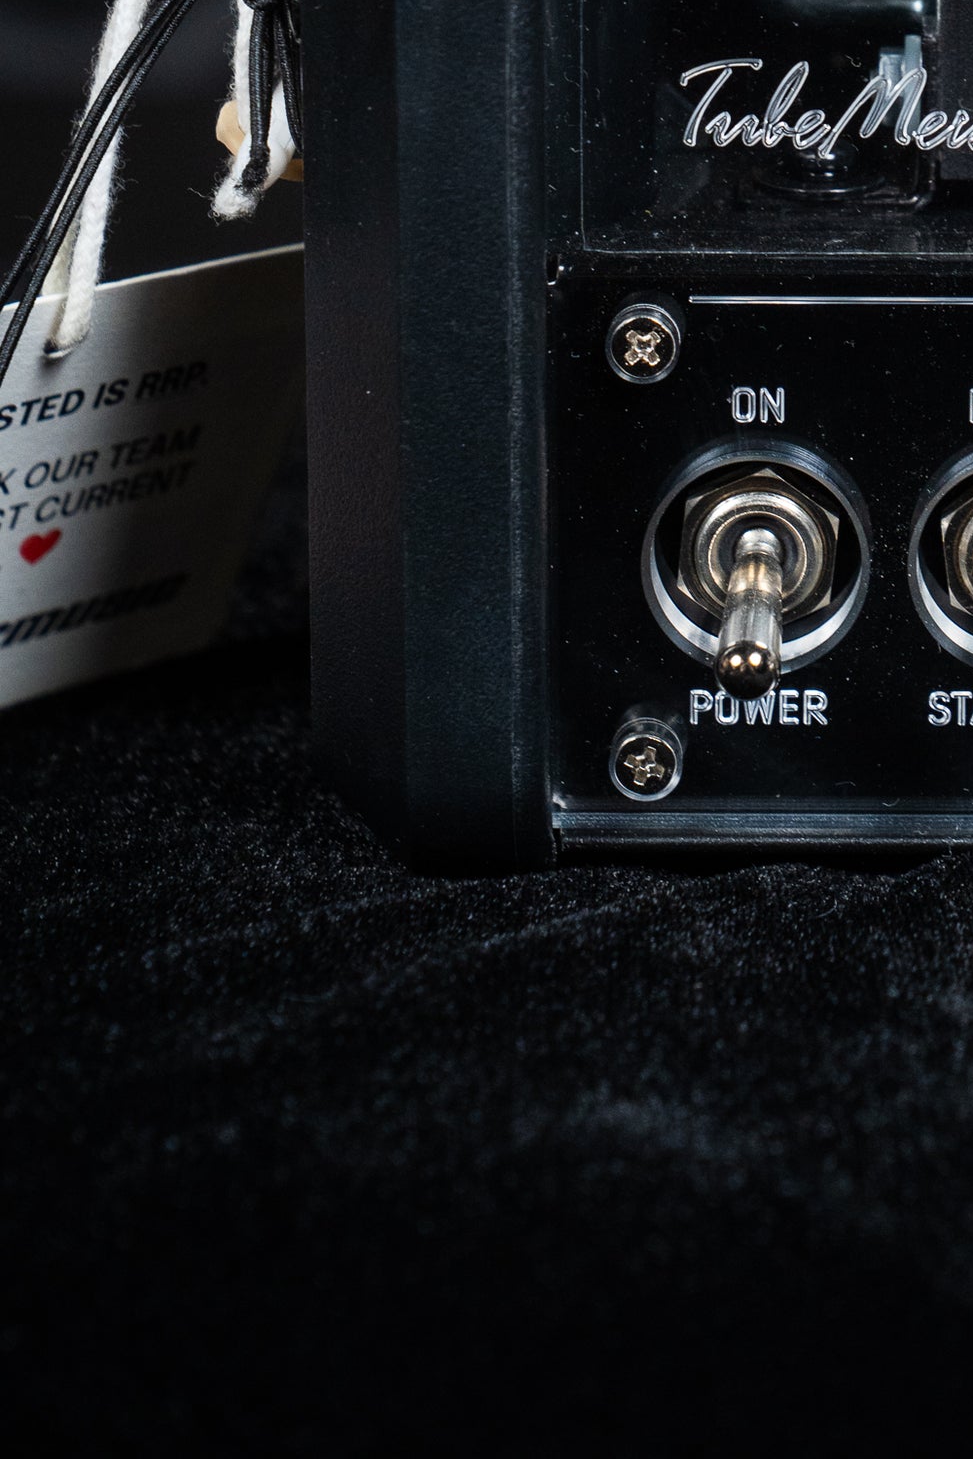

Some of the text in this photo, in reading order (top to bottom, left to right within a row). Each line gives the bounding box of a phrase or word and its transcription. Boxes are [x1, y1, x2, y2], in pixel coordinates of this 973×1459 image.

[93, 378, 129, 409] IS
[731, 387, 785, 424] ON
[24, 450, 99, 489] OUR
[110, 424, 201, 468] TEAM
[35, 461, 194, 523] CURRENT
[689, 688, 829, 727] POWER
